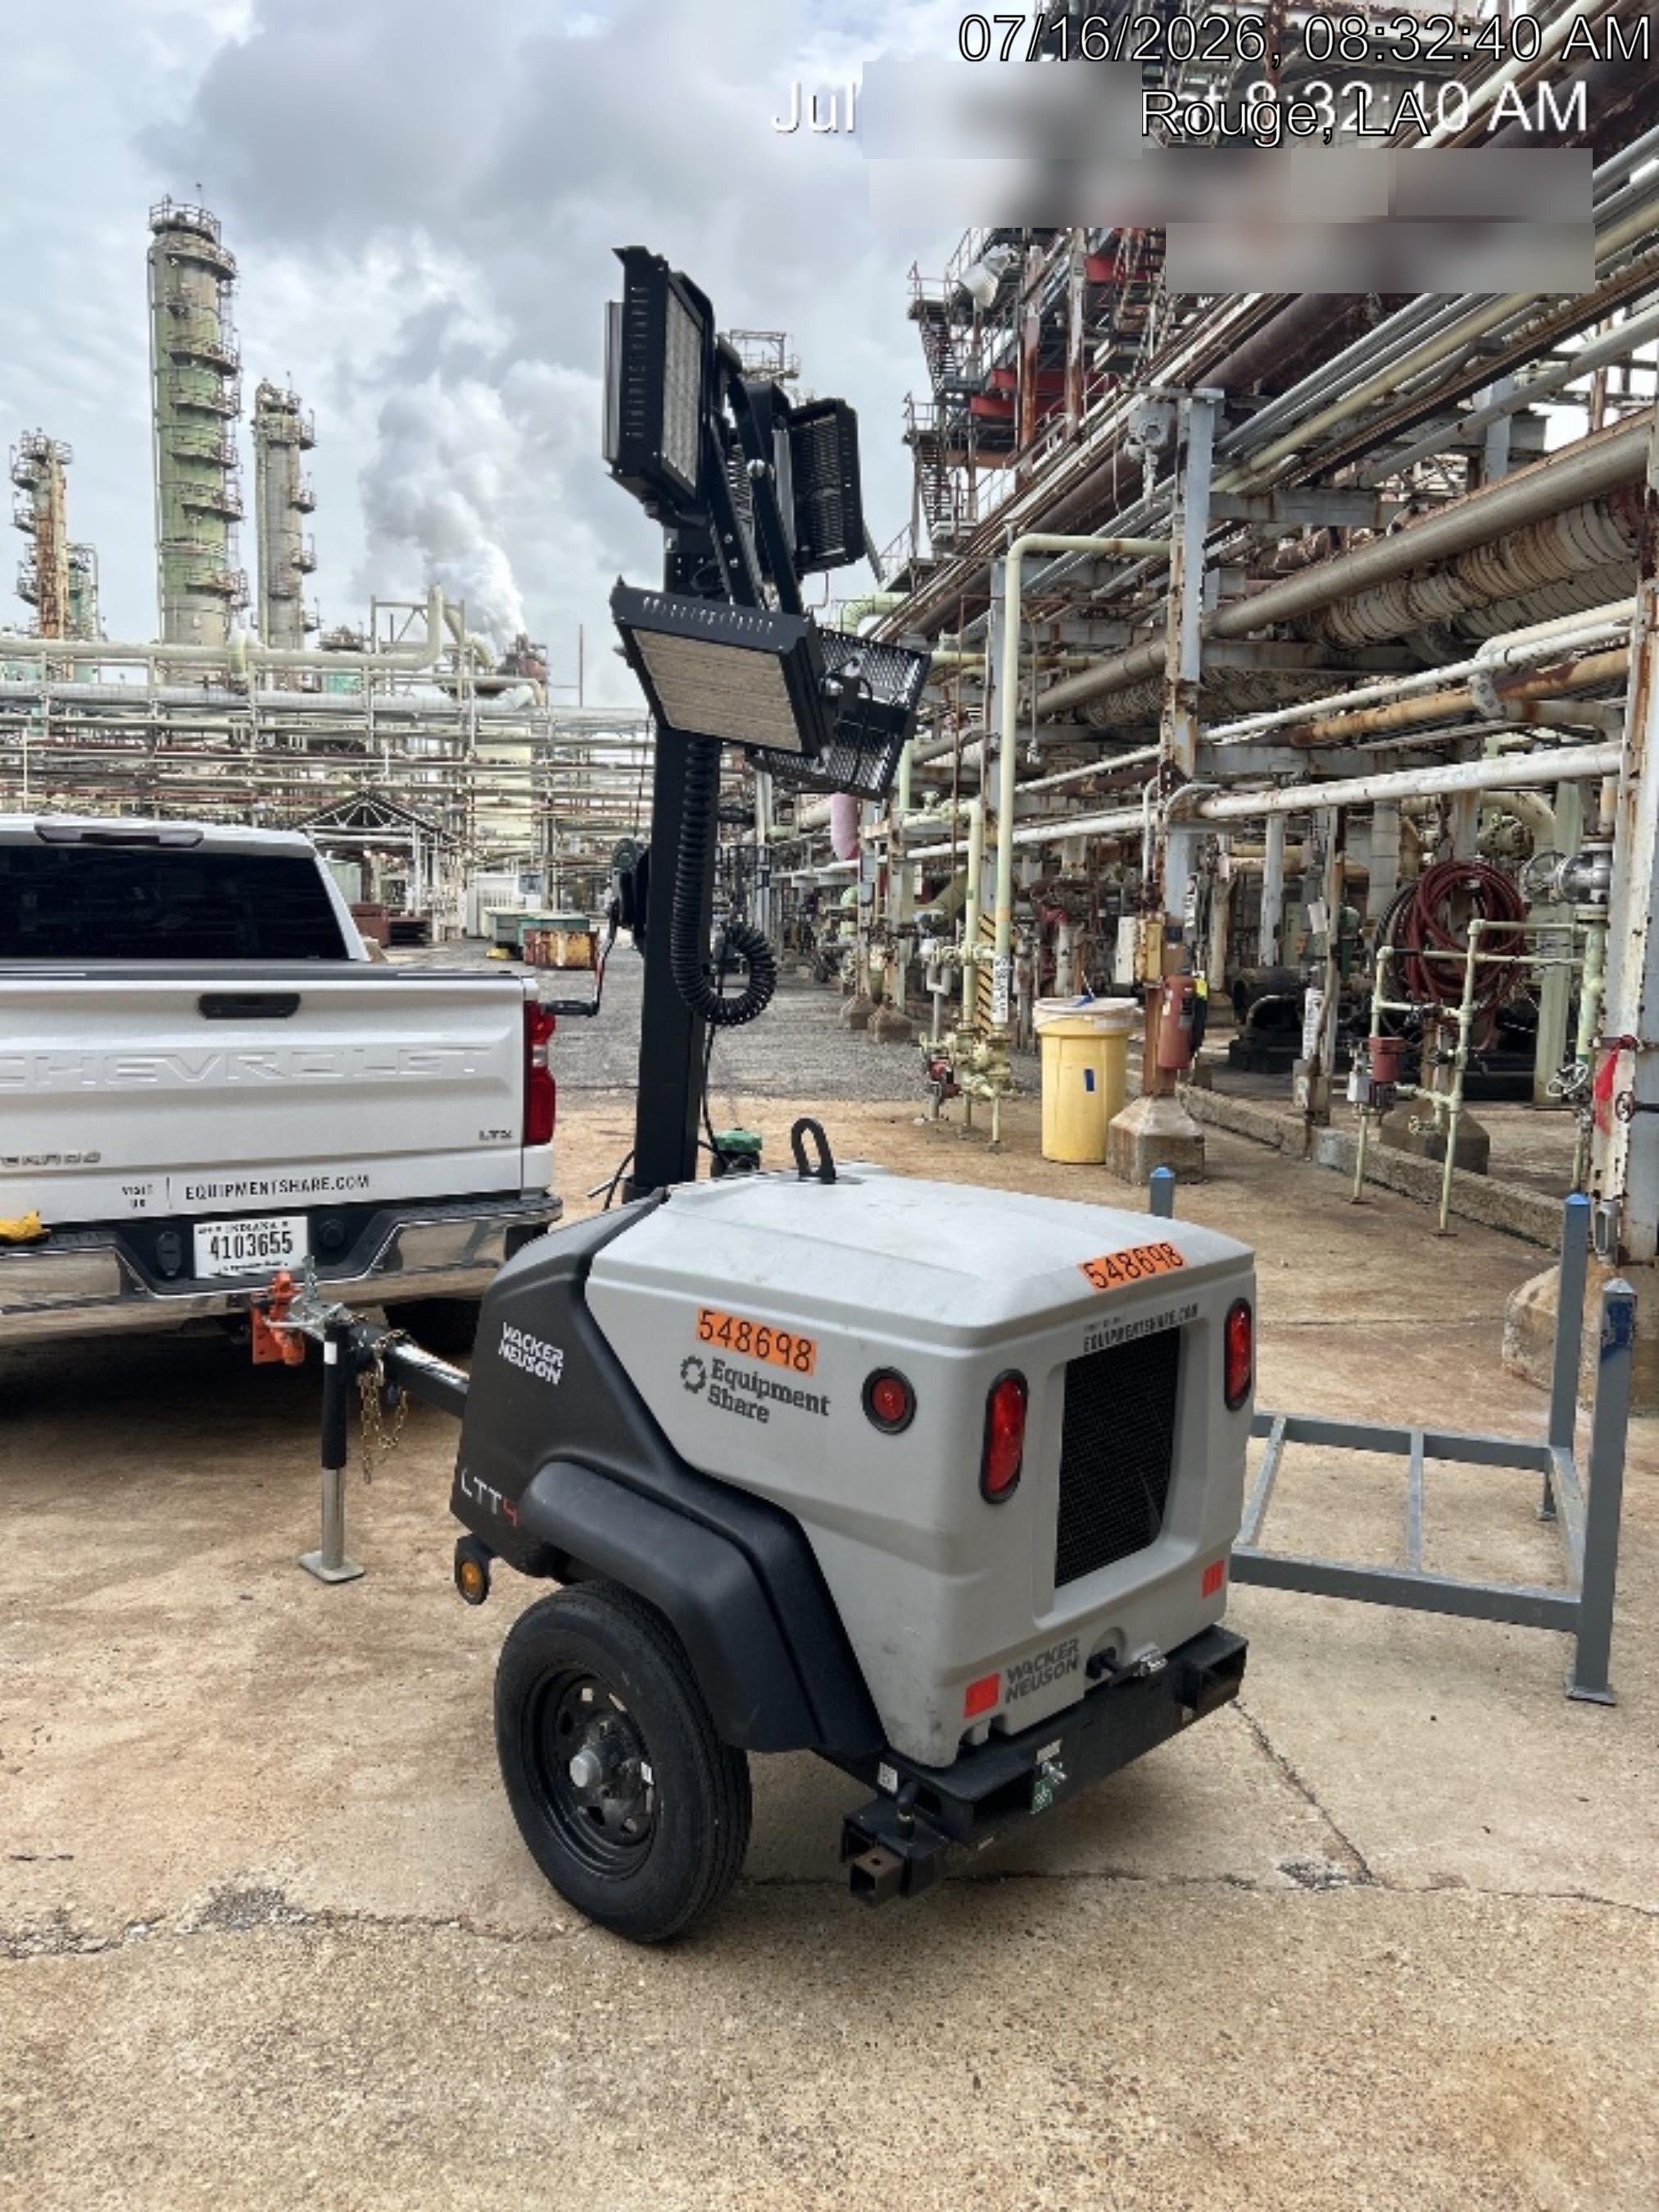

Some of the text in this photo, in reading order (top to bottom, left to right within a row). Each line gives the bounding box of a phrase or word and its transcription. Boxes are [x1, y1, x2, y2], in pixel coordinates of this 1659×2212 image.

[185, 1174, 370, 1200] EQUIPMENTSHARE.COM
[210, 1231, 293, 1261] 4103655
[1083, 1242, 1184, 1289] 548698
[497, 1339, 563, 1386] NEUSON
[502, 1321, 564, 1367] WACKER
[699, 1310, 812, 1373] 548698
[707, 1384, 770, 1425] Share
[710, 1356, 832, 1417] Equipment
[460, 1467, 518, 1527] LTT4
[1004, 1655, 1079, 1704] NEUSON
[1007, 1638, 1080, 1685] WACKER
